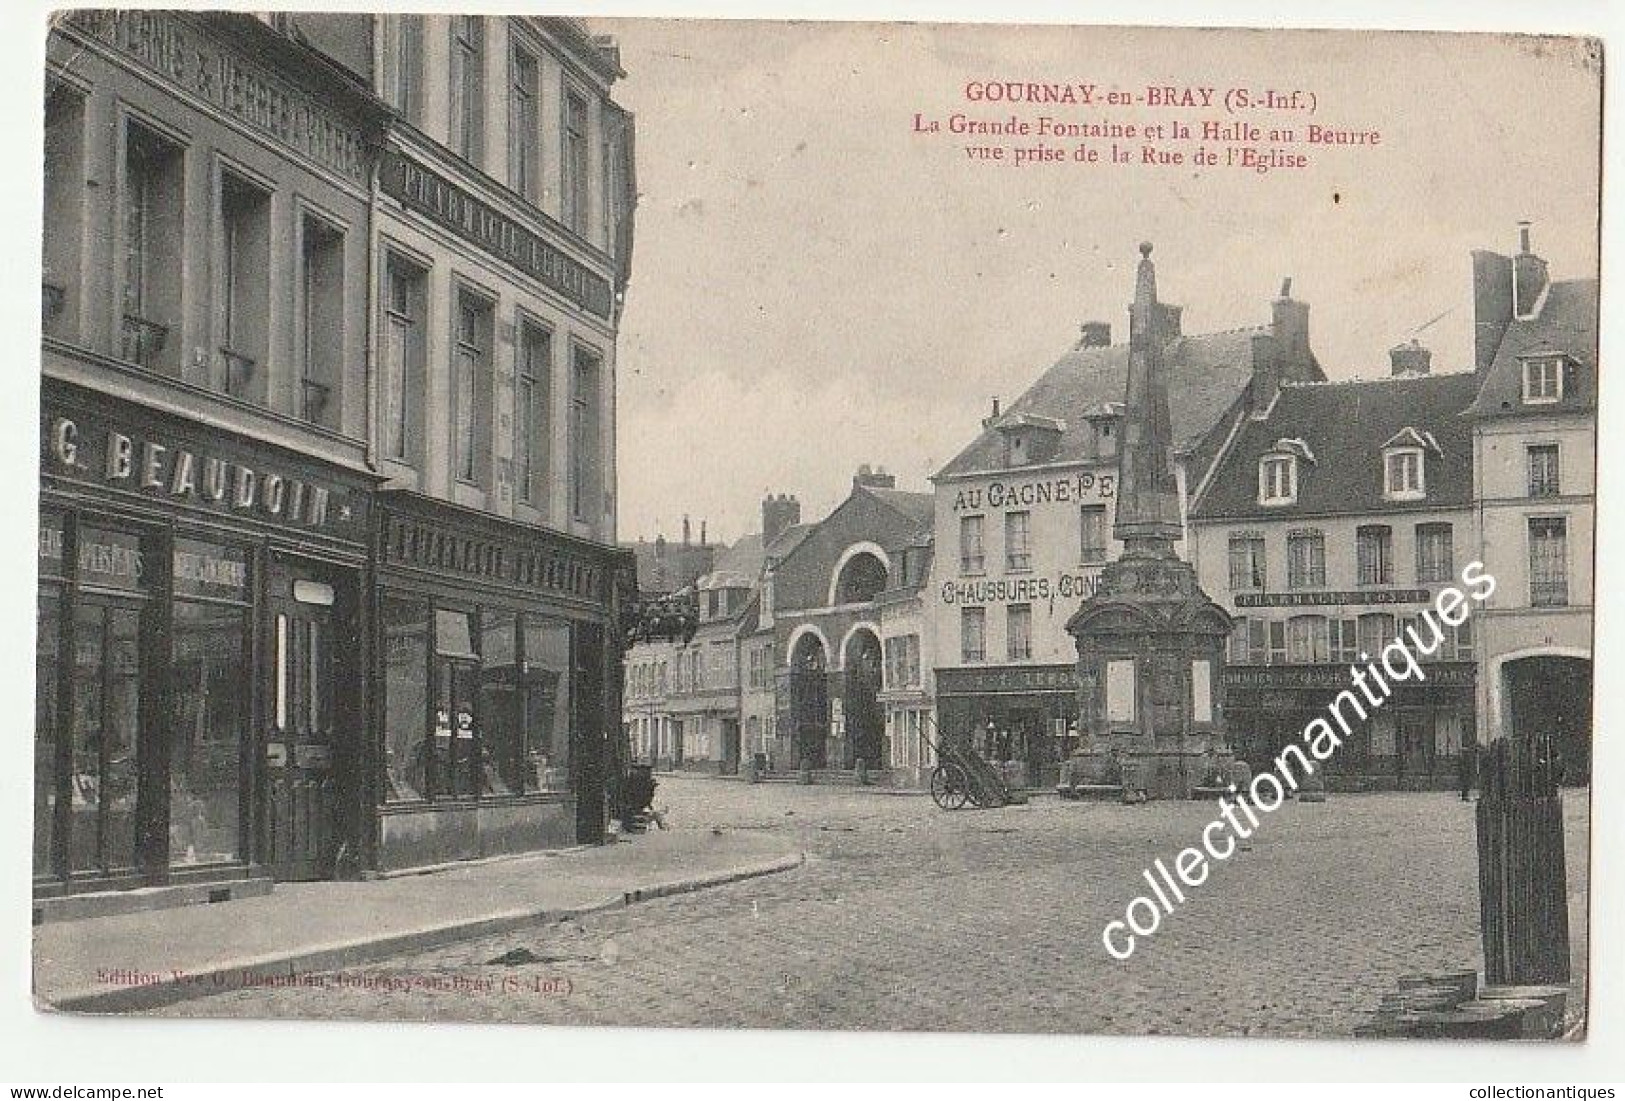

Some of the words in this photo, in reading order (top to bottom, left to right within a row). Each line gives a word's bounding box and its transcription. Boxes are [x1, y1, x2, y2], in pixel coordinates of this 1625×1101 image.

[57, 415, 88, 470] G.
[106, 431, 329, 526] BEAUDOIN
[953, 489, 982, 511] AU
